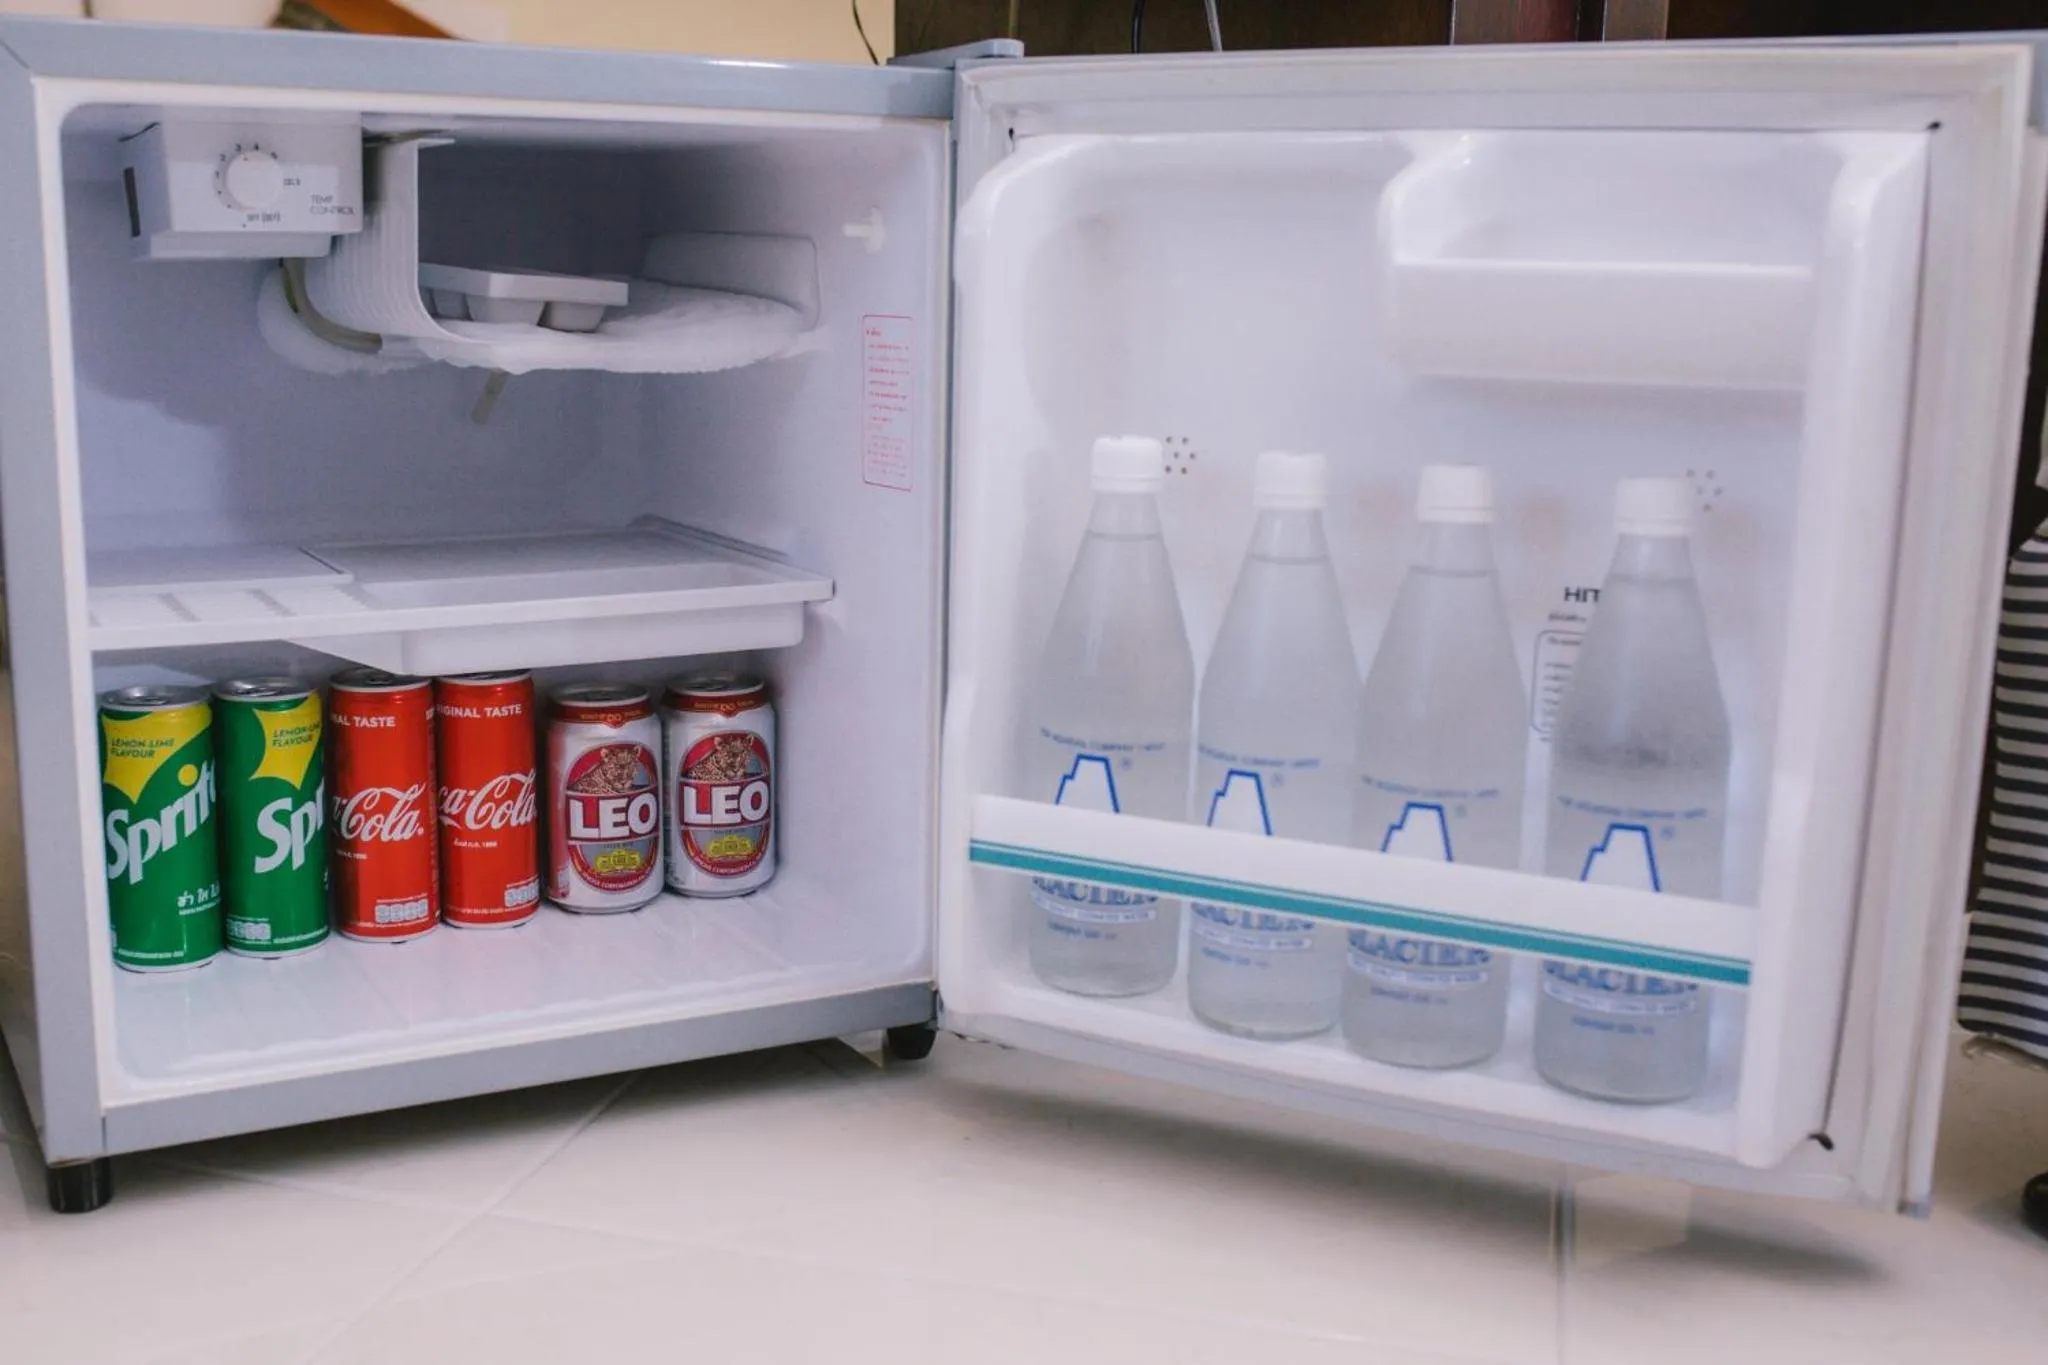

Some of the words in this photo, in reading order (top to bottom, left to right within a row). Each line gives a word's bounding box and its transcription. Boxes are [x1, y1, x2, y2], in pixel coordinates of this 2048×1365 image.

[1564, 586, 1601, 603] HIT
[484, 703, 523, 718] TASTE
[353, 716, 397, 728] TASTE
[111, 749, 156, 758] FLAVOUR
[683, 780, 770, 825] LEO
[569, 792, 658, 839] LEO
